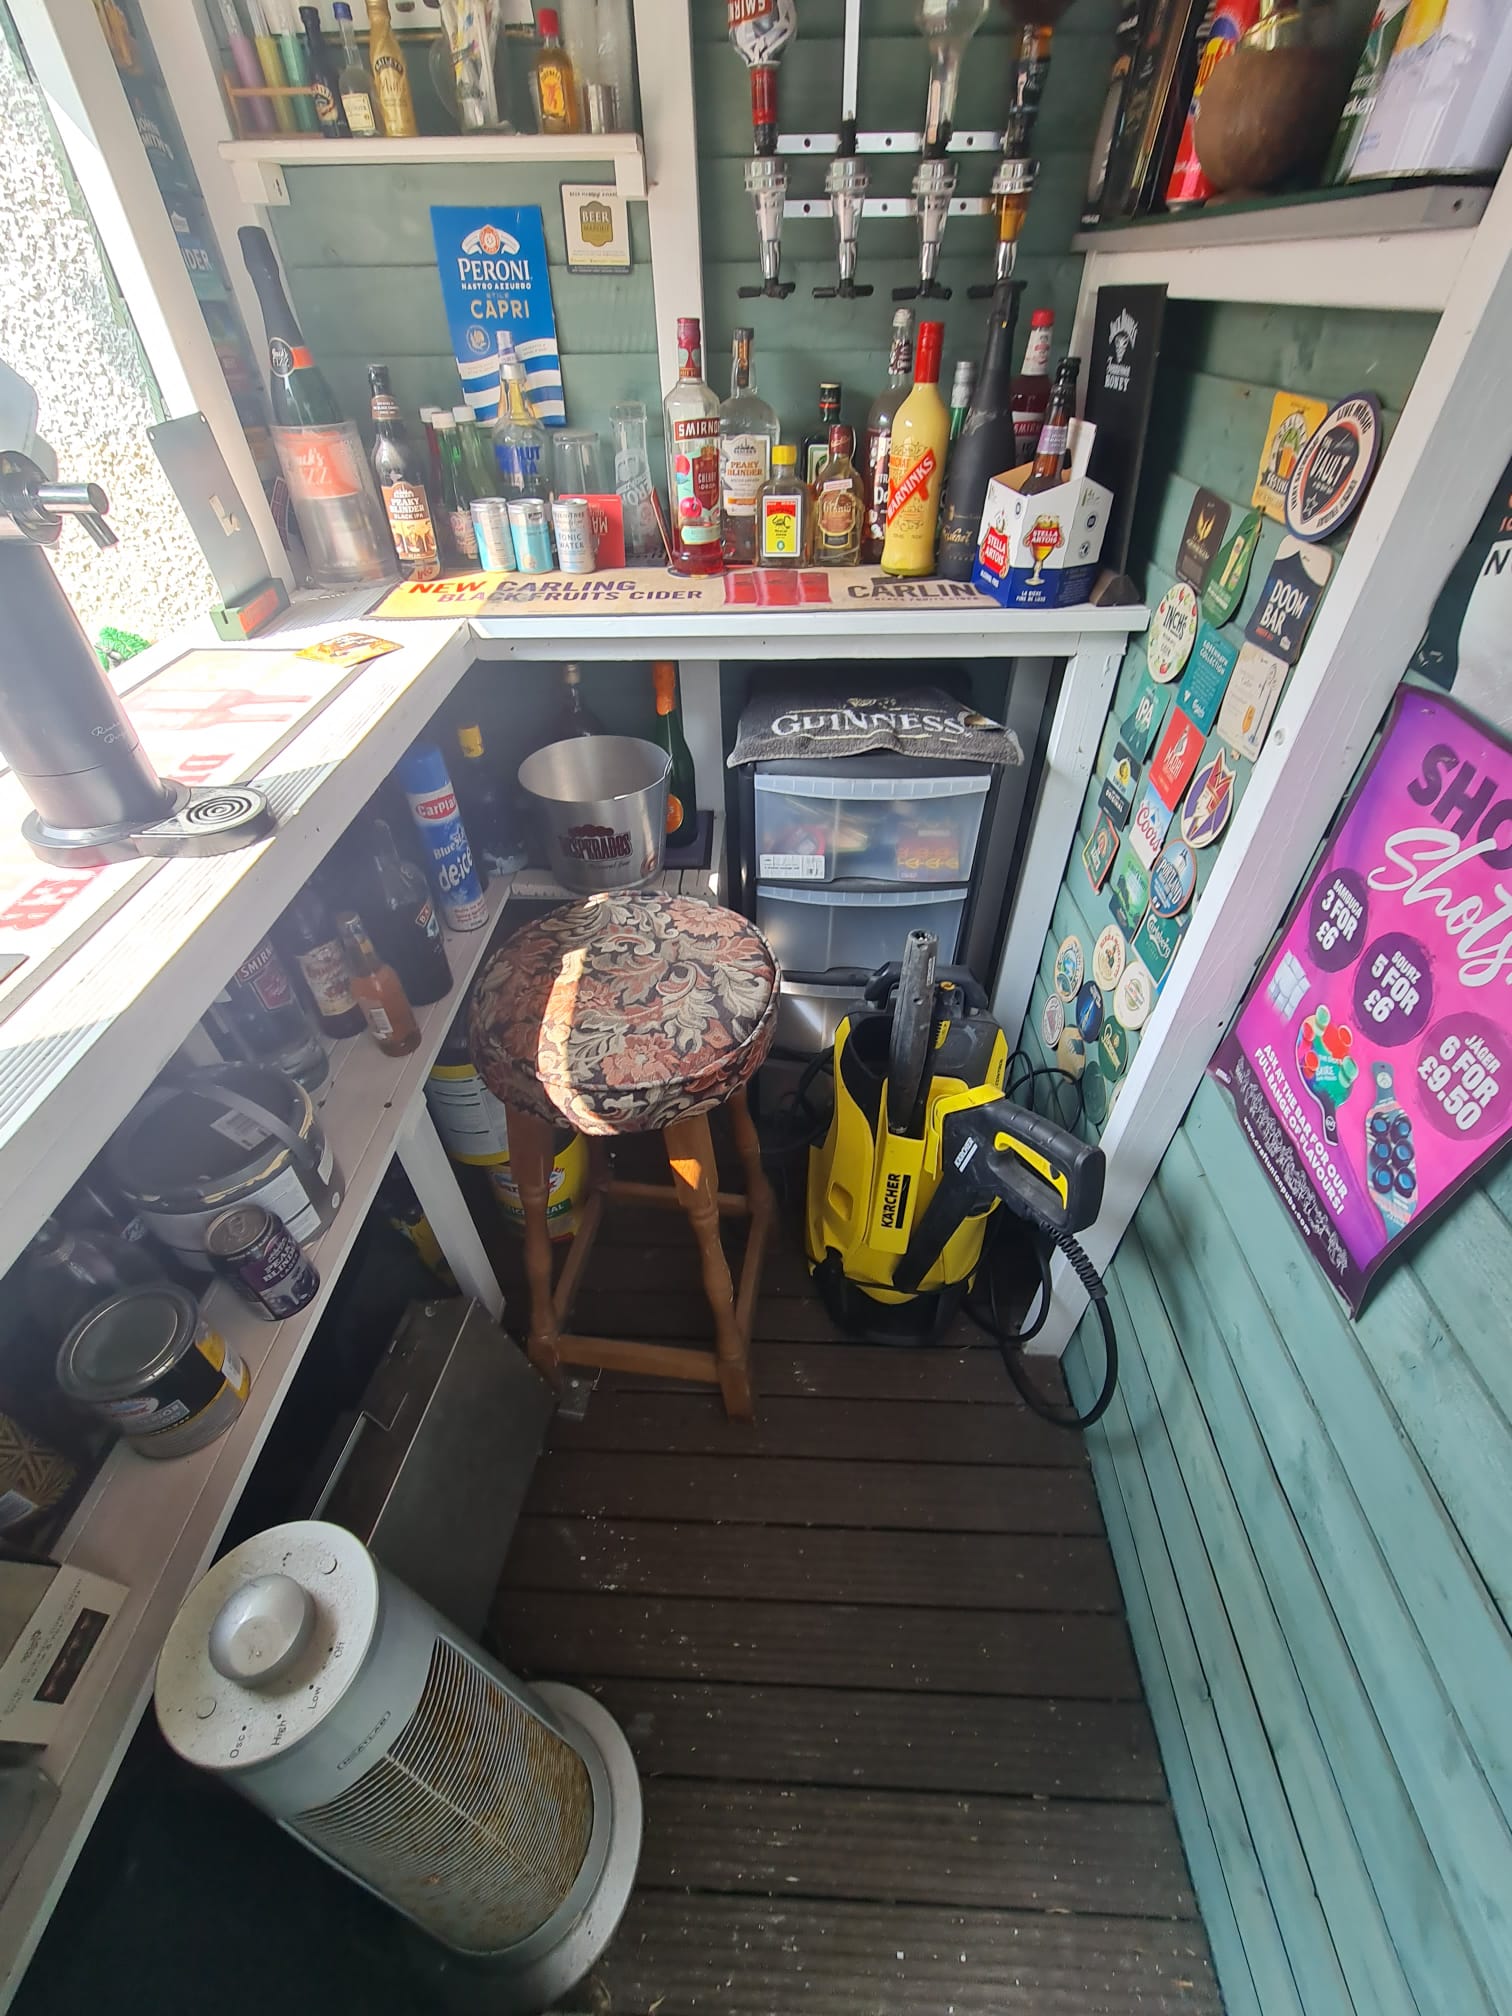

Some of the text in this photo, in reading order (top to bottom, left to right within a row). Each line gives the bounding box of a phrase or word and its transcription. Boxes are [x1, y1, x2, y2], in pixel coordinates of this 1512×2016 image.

[581, 210, 610, 224] BEER
[457, 258, 531, 282] PERONI
[470, 300, 530, 319] CAPRI
[678, 417, 721, 438] SMIRNO
[1336, 401, 1373, 435] LIVE MUSIC
[727, 467, 763, 477] BLINDER
[730, 460, 760, 469] PEAKY
[1309, 447, 1351, 487] VAULT
[558, 533, 583, 542] TONIC
[559, 541, 585, 550] WATER
[987, 533, 1006, 554] STELLA
[1031, 536, 1058, 544] ARTOIS
[1032, 529, 1059, 538] STELLA
[985, 545, 1005, 566] ARTOIS
[408, 581, 637, 594] NEW CARLING
[629, 590, 703, 600] CIDER
[848, 584, 977, 598] CARLIN
[1271, 577, 1309, 623] DOOM
[1259, 603, 1290, 637] BAR
[770, 708, 965, 737] GUINNESS
[1135, 695, 1155, 729] IPA
[1136, 801, 1164, 853] Coors
[1156, 858, 1184, 905] PORTLAND
[1333, 878, 1363, 917] SAMBUCA
[1321, 889, 1358, 942] 3 FOR
[1147, 914, 1171, 959] Carlsberg
[1315, 921, 1340, 951] £6
[239, 947, 272, 979] SMIRN
[1391, 951, 1421, 986] SOURZ
[1371, 952, 1420, 1016] 5 FOR
[1363, 988, 1394, 1024] £6
[1464, 1034, 1501, 1074] JÄGER
[1439, 1035, 1500, 1108] 6 FOR
[1417, 1055, 1482, 1131] £9.50
[1254, 1047, 1344, 1216] FULL RANGE OF FLAVOURS!
[1263, 1044, 1279, 1069] ASK
[1281, 1081, 1298, 1108] THE
[1293, 1105, 1312, 1136] BAR
[1308, 1134, 1330, 1166] FOR
[1326, 1162, 1348, 1200] OUR
[1243, 1116, 1311, 1236] www.craftunionpubs.com
[881, 1173, 901, 1229] KÄRCHER
[333, 1640, 346, 1659] Off
[308, 1685, 322, 1710] Low
[229, 1734, 246, 1759] Osc
[271, 1718, 288, 1746] High
